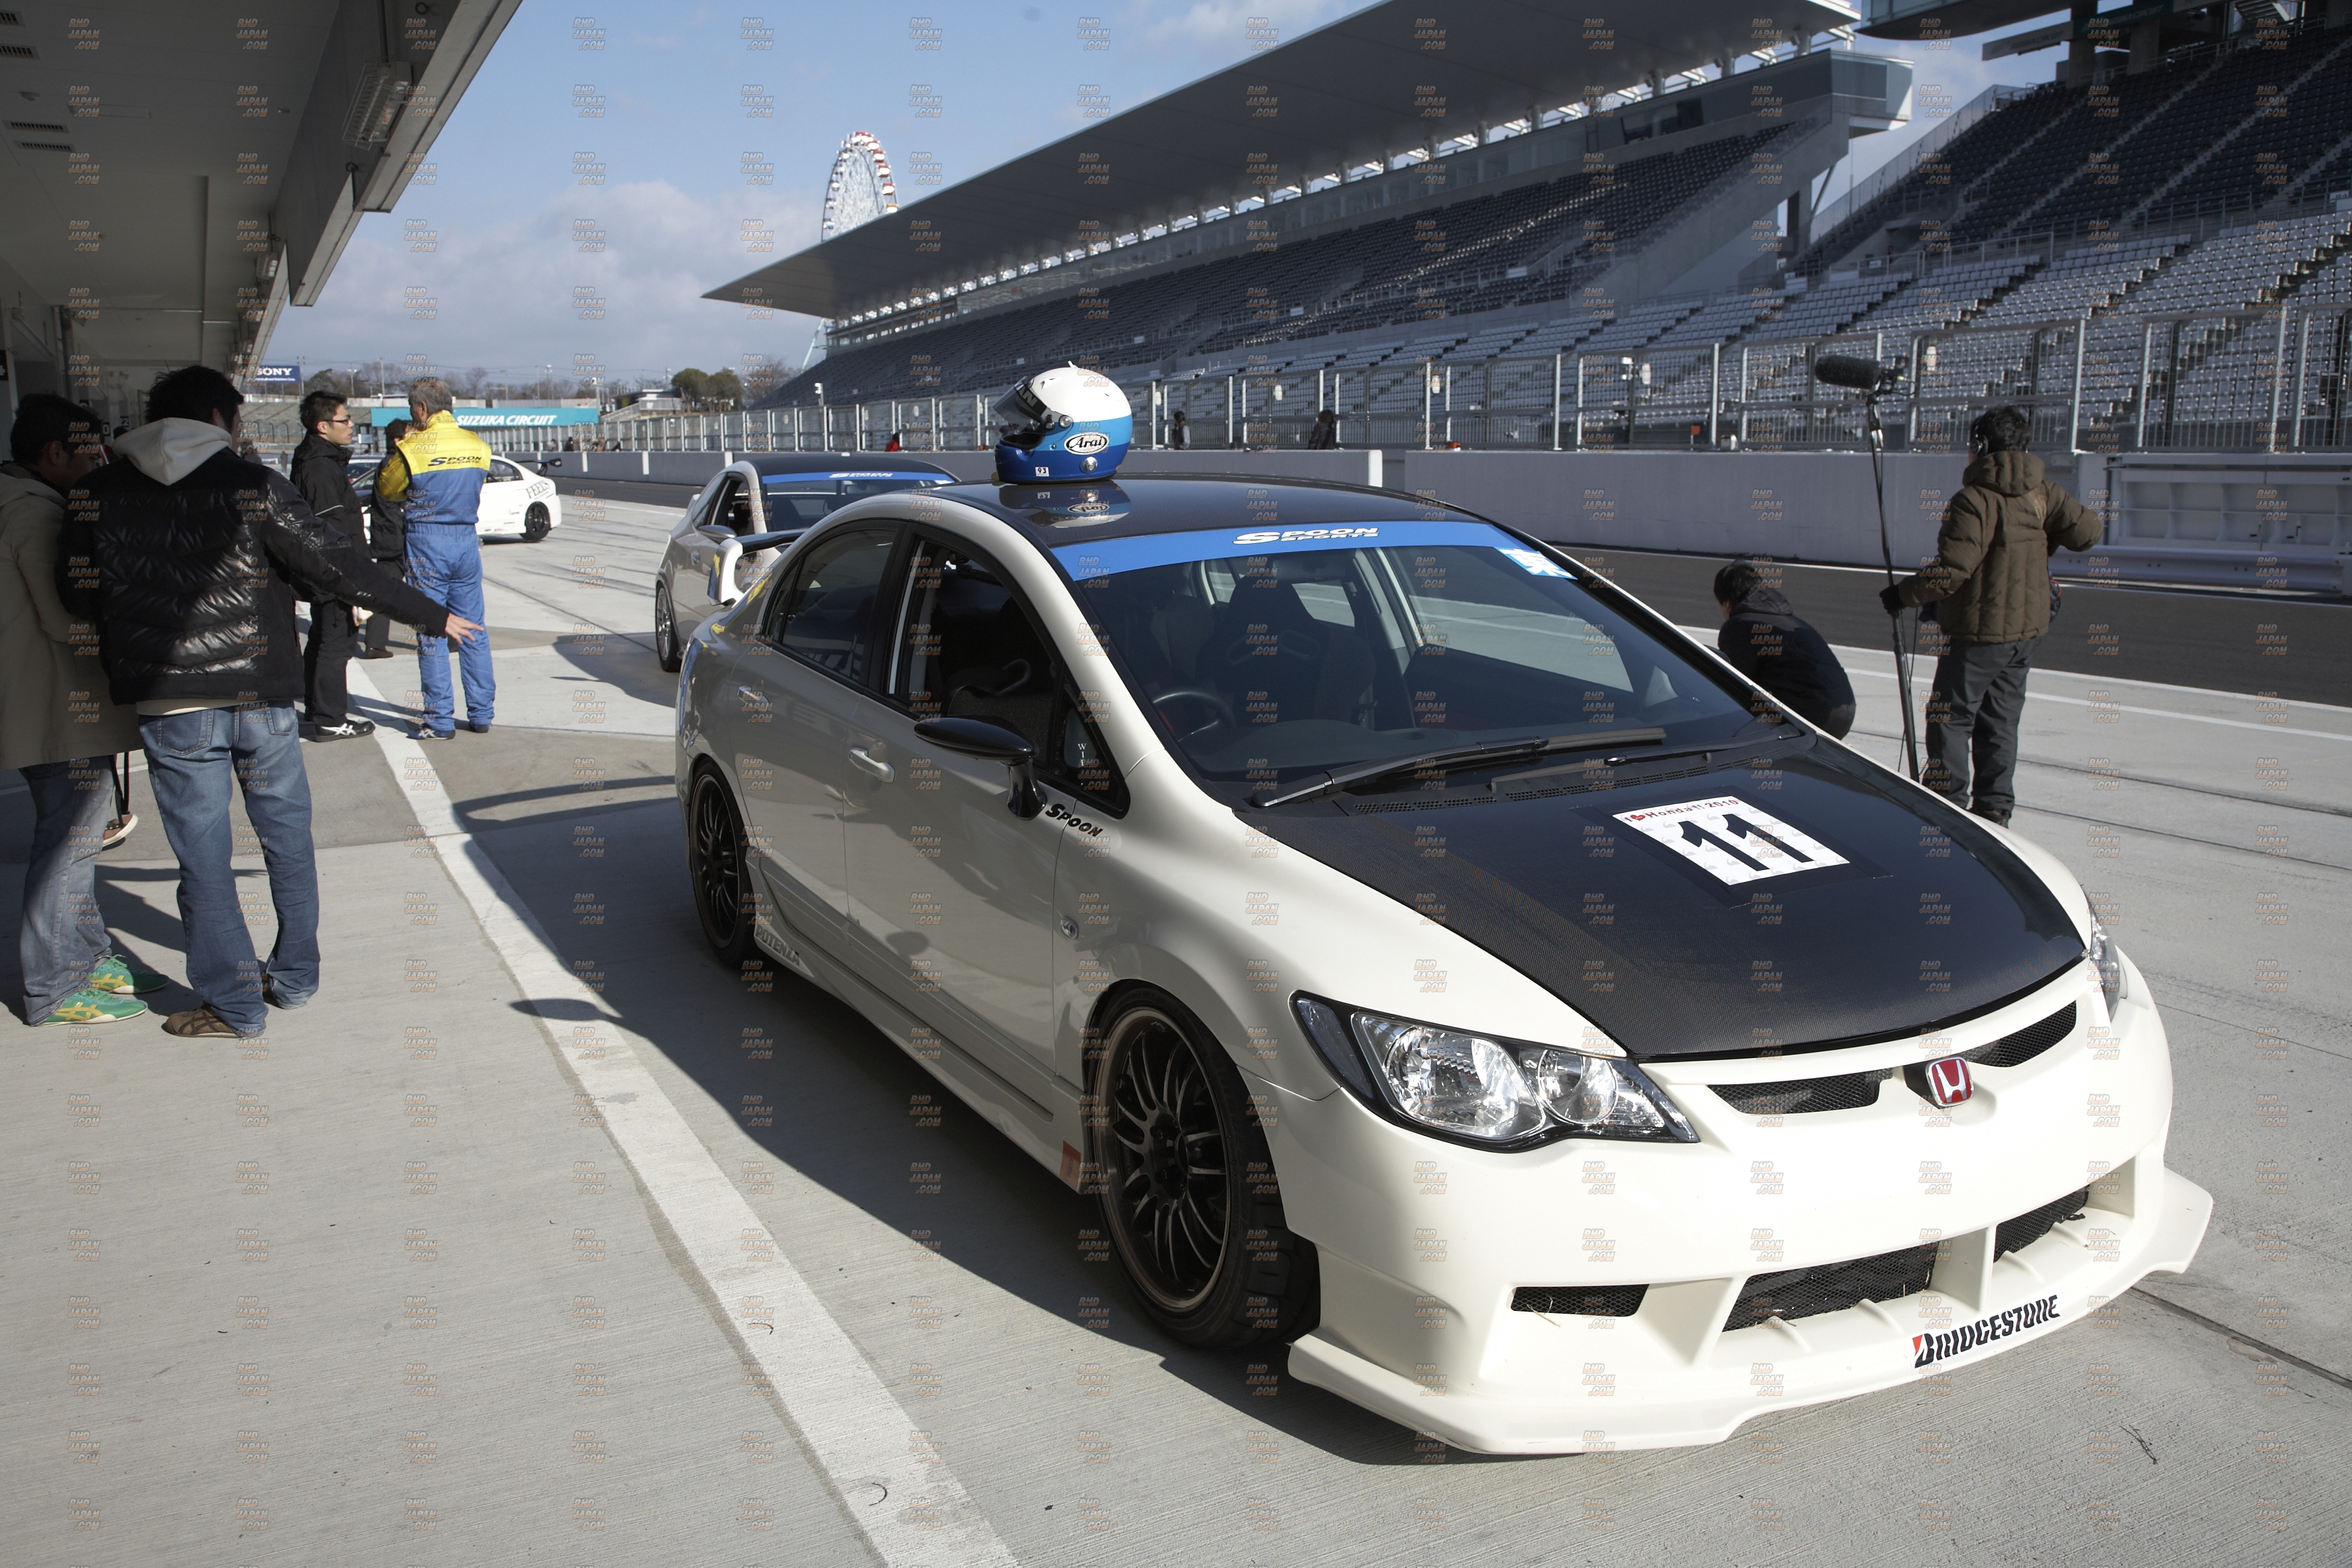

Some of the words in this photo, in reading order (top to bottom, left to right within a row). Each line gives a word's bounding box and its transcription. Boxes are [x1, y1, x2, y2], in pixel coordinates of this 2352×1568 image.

[257, 367, 293, 376] SONY
[456, 415, 504, 425] SUZUKA
[506, 415, 557, 425] CIRCUIT
[1069, 436, 1103, 449] Arai
[428, 456, 481, 466] SPOON
[1233, 528, 1379, 544] SPOON
[1705, 799, 1739, 808] 2010
[1045, 804, 1104, 836] SPOON
[1677, 813, 1815, 871] 11
[756, 924, 800, 966] POTENZA
[1912, 1295, 2061, 1368] BRIDGESTONE
